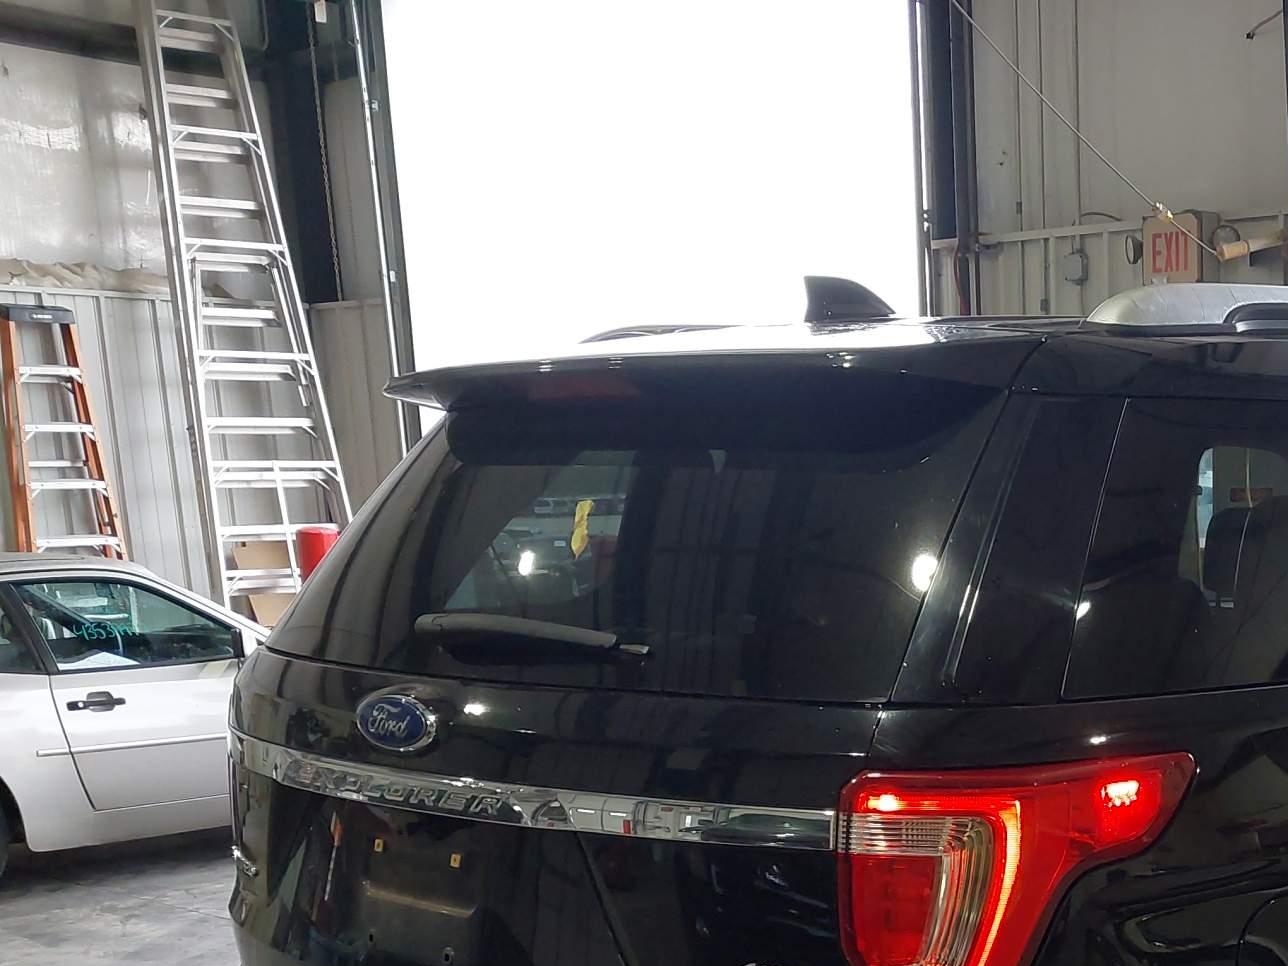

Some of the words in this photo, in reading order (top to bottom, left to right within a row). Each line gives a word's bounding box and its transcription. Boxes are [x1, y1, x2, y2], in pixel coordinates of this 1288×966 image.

[1151, 231, 1192, 273] EXIT
[368, 703, 411, 737] Ford
[296, 762, 503, 815] EXPLORER
